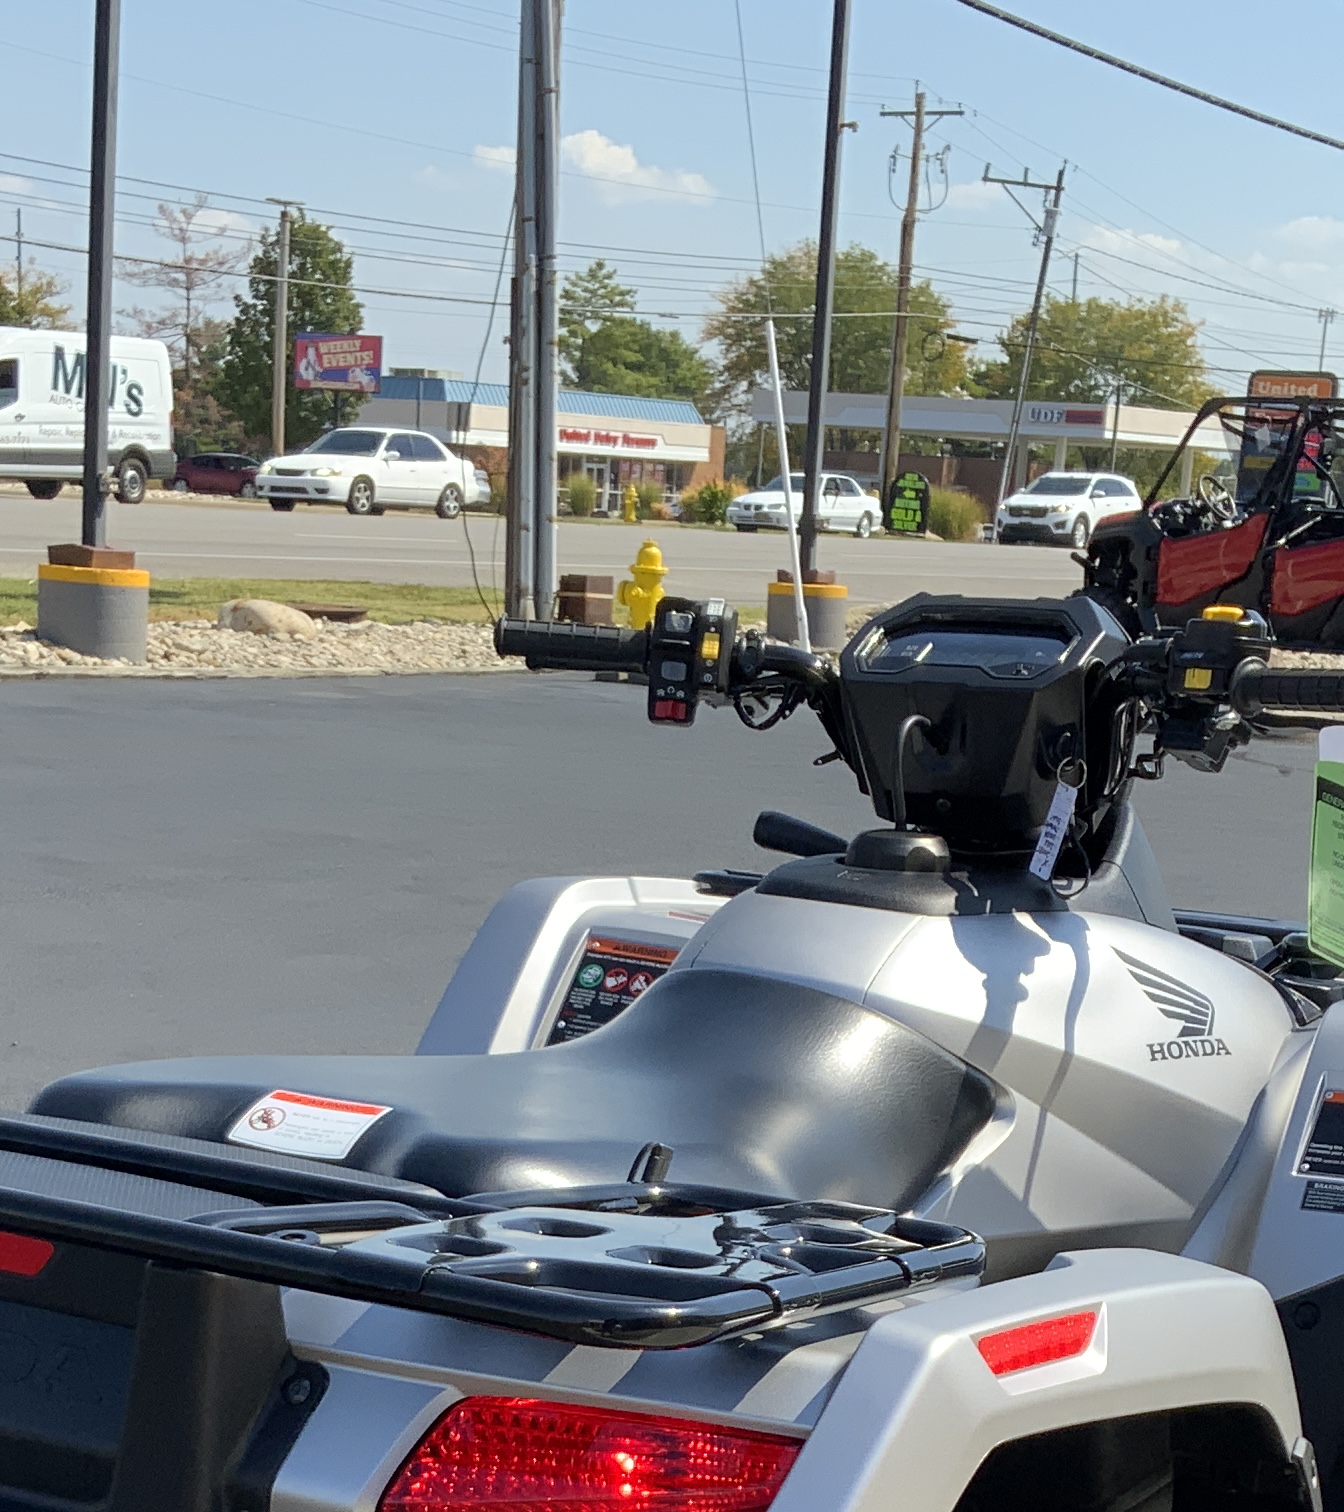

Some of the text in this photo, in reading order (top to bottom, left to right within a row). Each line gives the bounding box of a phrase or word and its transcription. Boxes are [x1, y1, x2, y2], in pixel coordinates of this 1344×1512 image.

[1258, 381, 1318, 397] United
[49, 394, 73, 409] AUTO
[1146, 1038, 1232, 1062] HONDA
